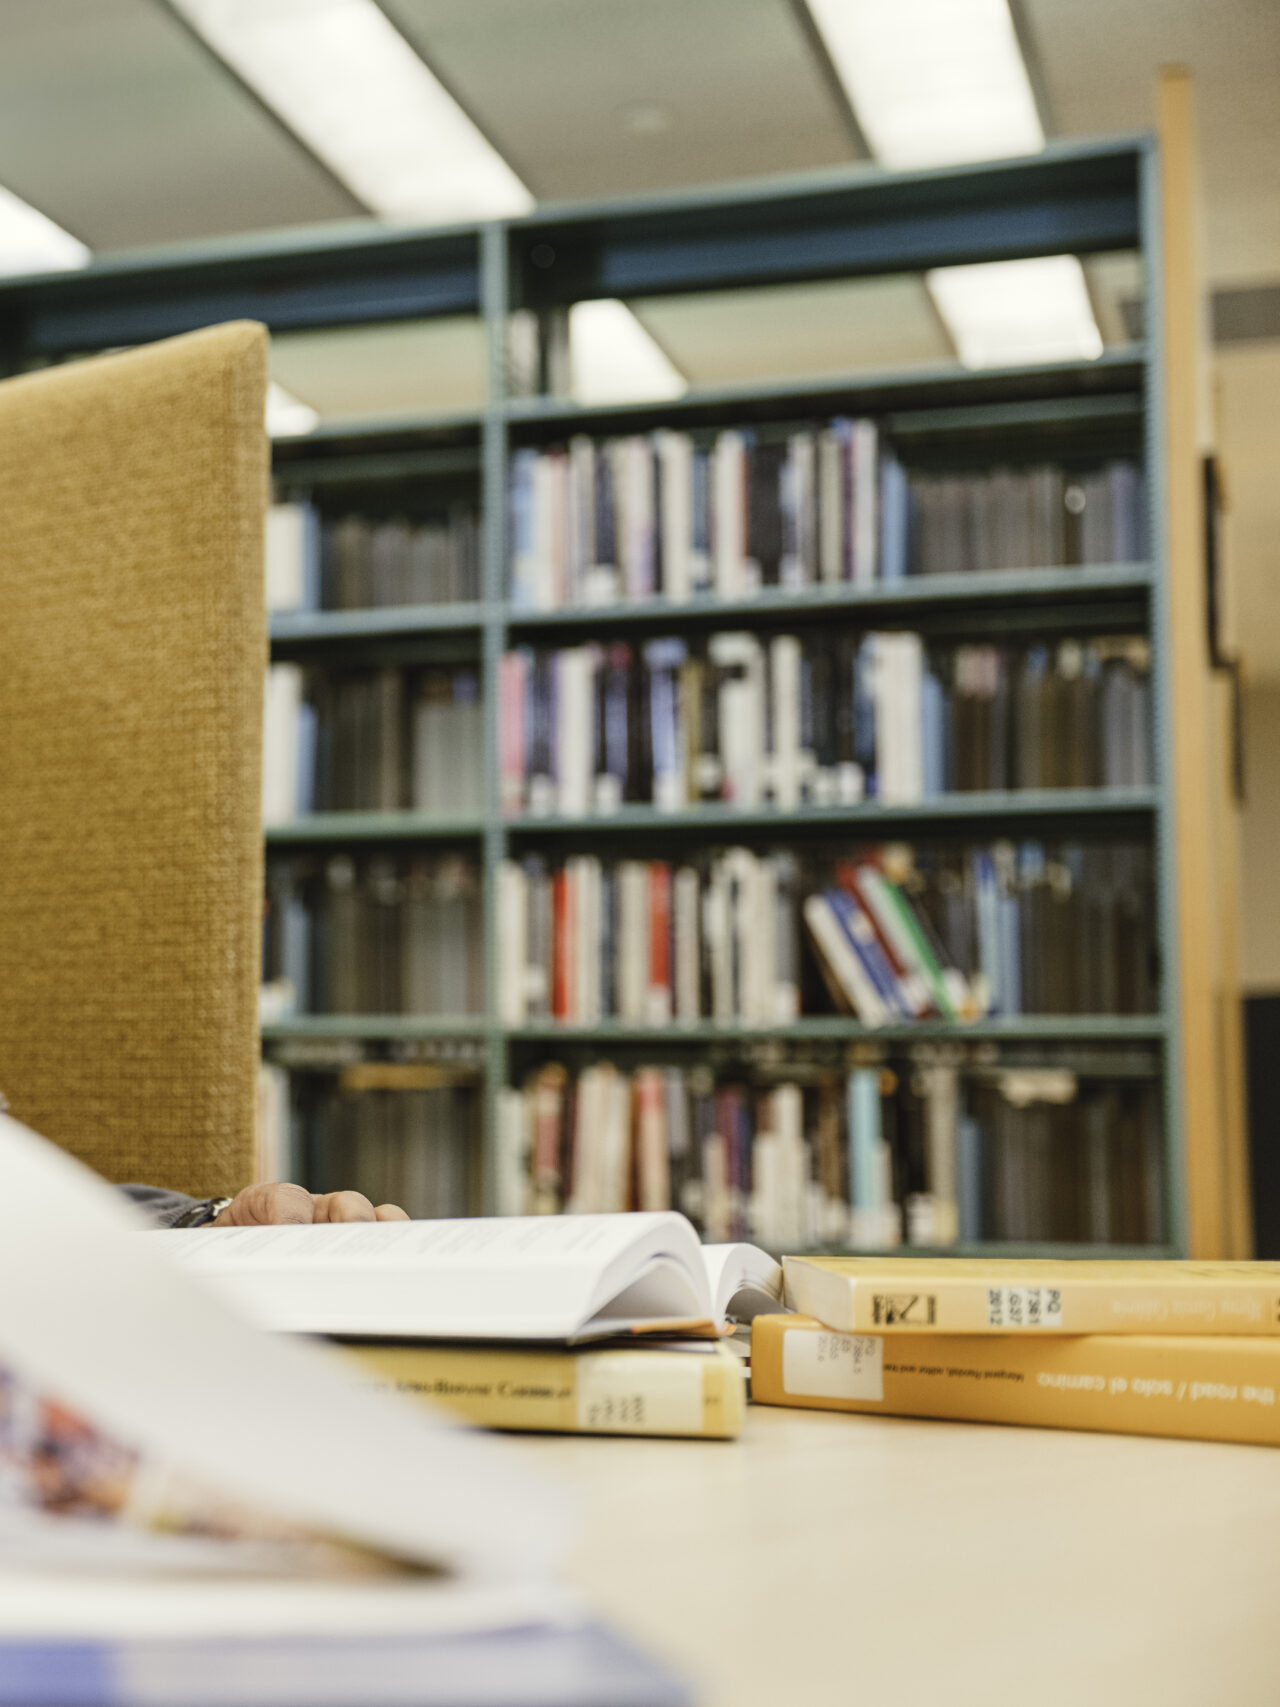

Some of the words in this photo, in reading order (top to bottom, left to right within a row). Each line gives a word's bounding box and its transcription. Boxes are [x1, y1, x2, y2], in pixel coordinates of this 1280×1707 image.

[1047, 1289, 1061, 1314] PQ
[1037, 1372, 1106, 1391] camino
[1109, 1376, 1128, 1395] el
[1132, 1378, 1173, 1398] solo
[1190, 1381, 1238, 1401] road
[1177, 1382, 1188, 1401] /
[1242, 1386, 1275, 1405] the
